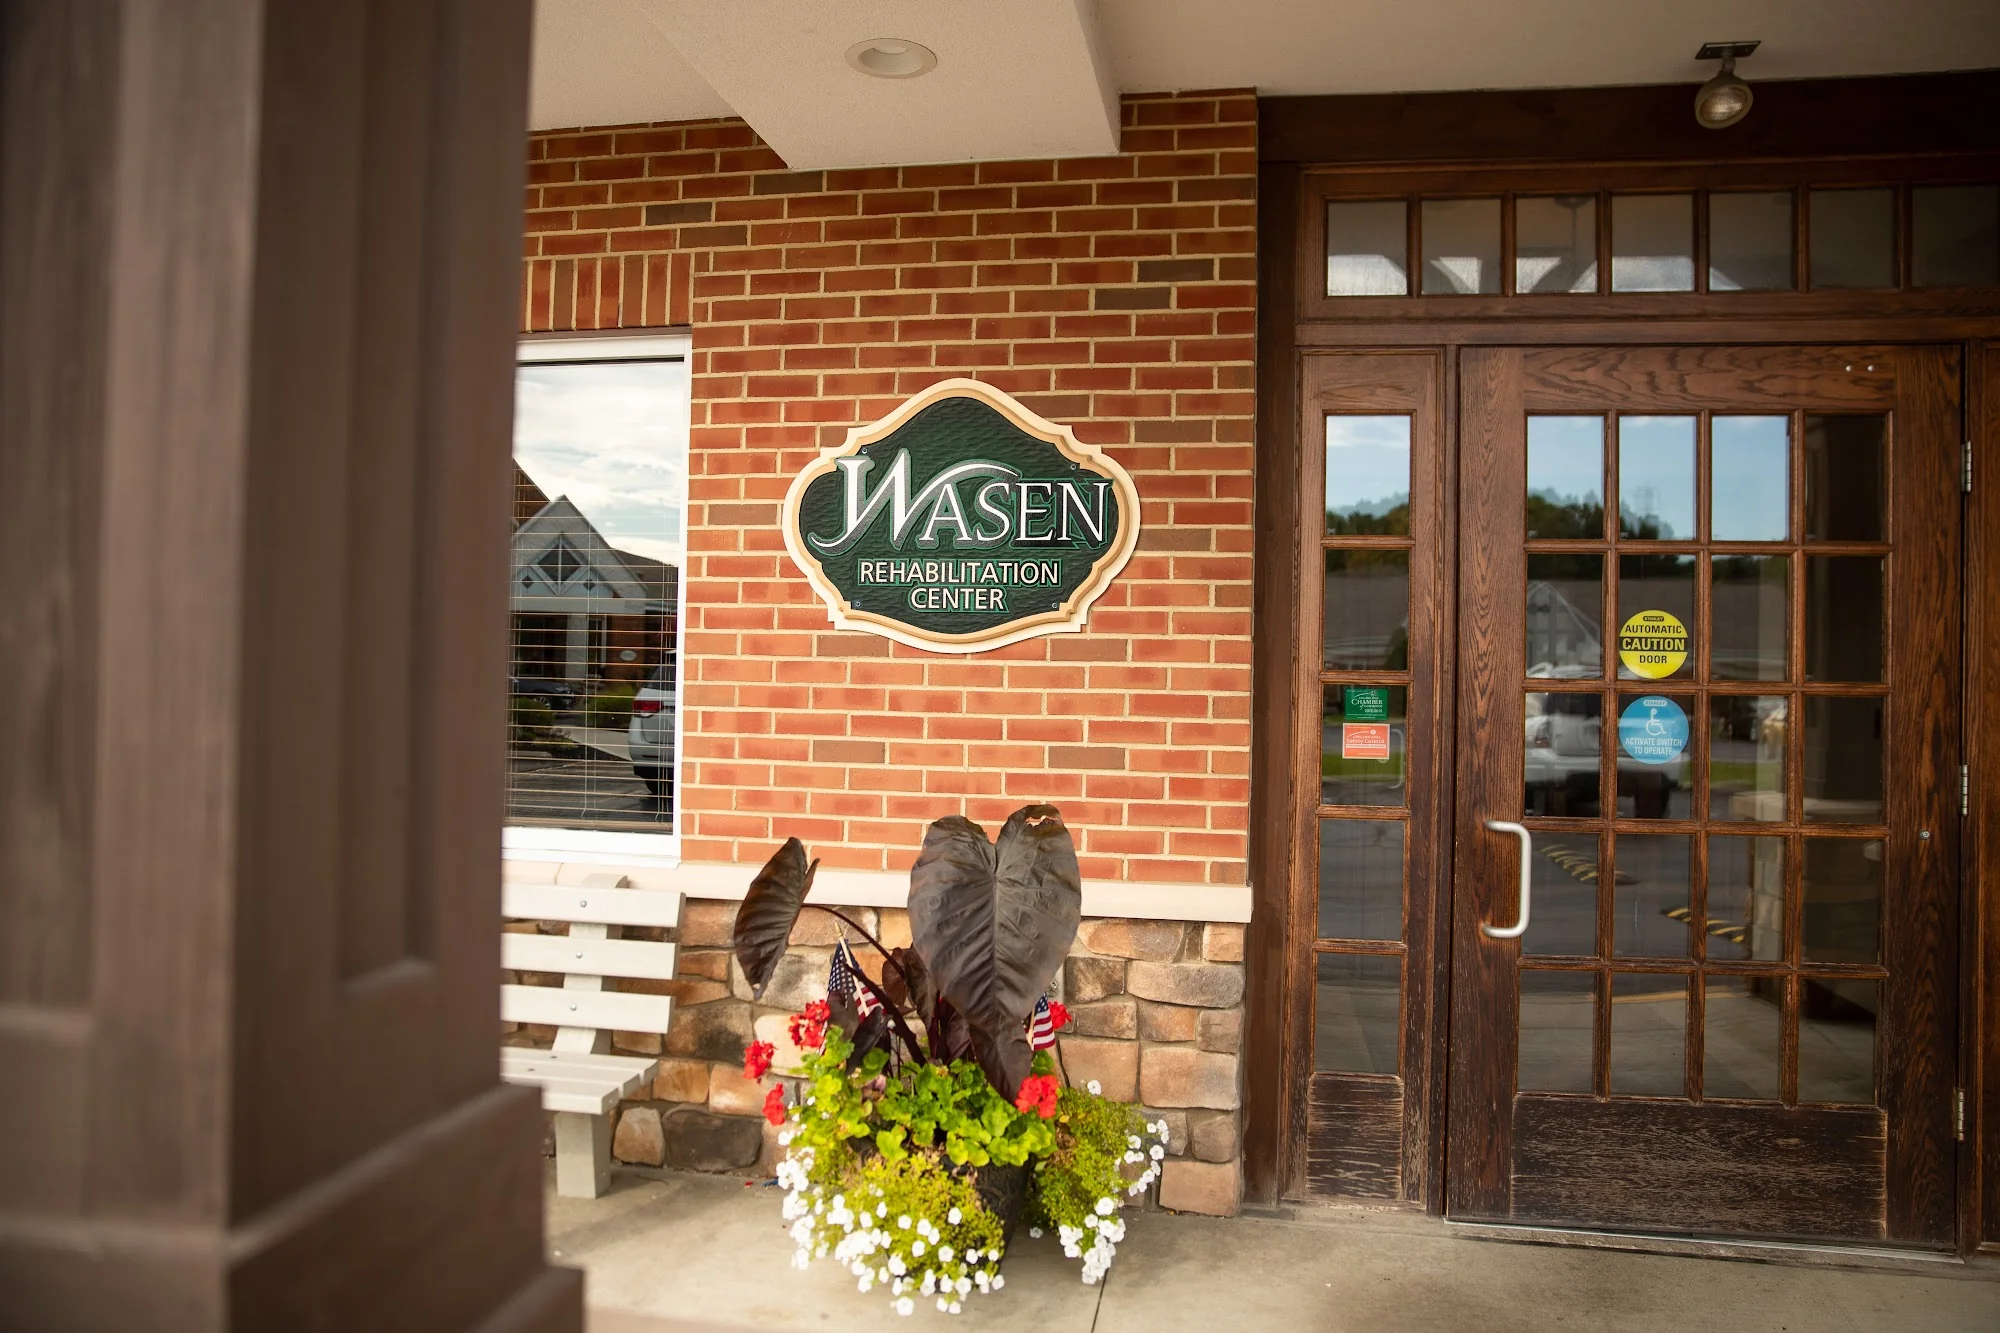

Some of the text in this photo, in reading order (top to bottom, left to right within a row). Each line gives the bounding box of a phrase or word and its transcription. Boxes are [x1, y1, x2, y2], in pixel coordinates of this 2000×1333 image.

[811, 449, 1110, 548] WASEN
[859, 561, 1059, 584] REHABILITATION
[910, 588, 1005, 610] CENTER
[1625, 624, 1682, 634] AUTOMATIC
[1622, 637, 1685, 651] CAUTION
[1639, 655, 1667, 664] DOOR
[1625, 737, 1683, 747] ACTIVATE SWITCH
[1633, 746, 1673, 755] TO OPERATE
